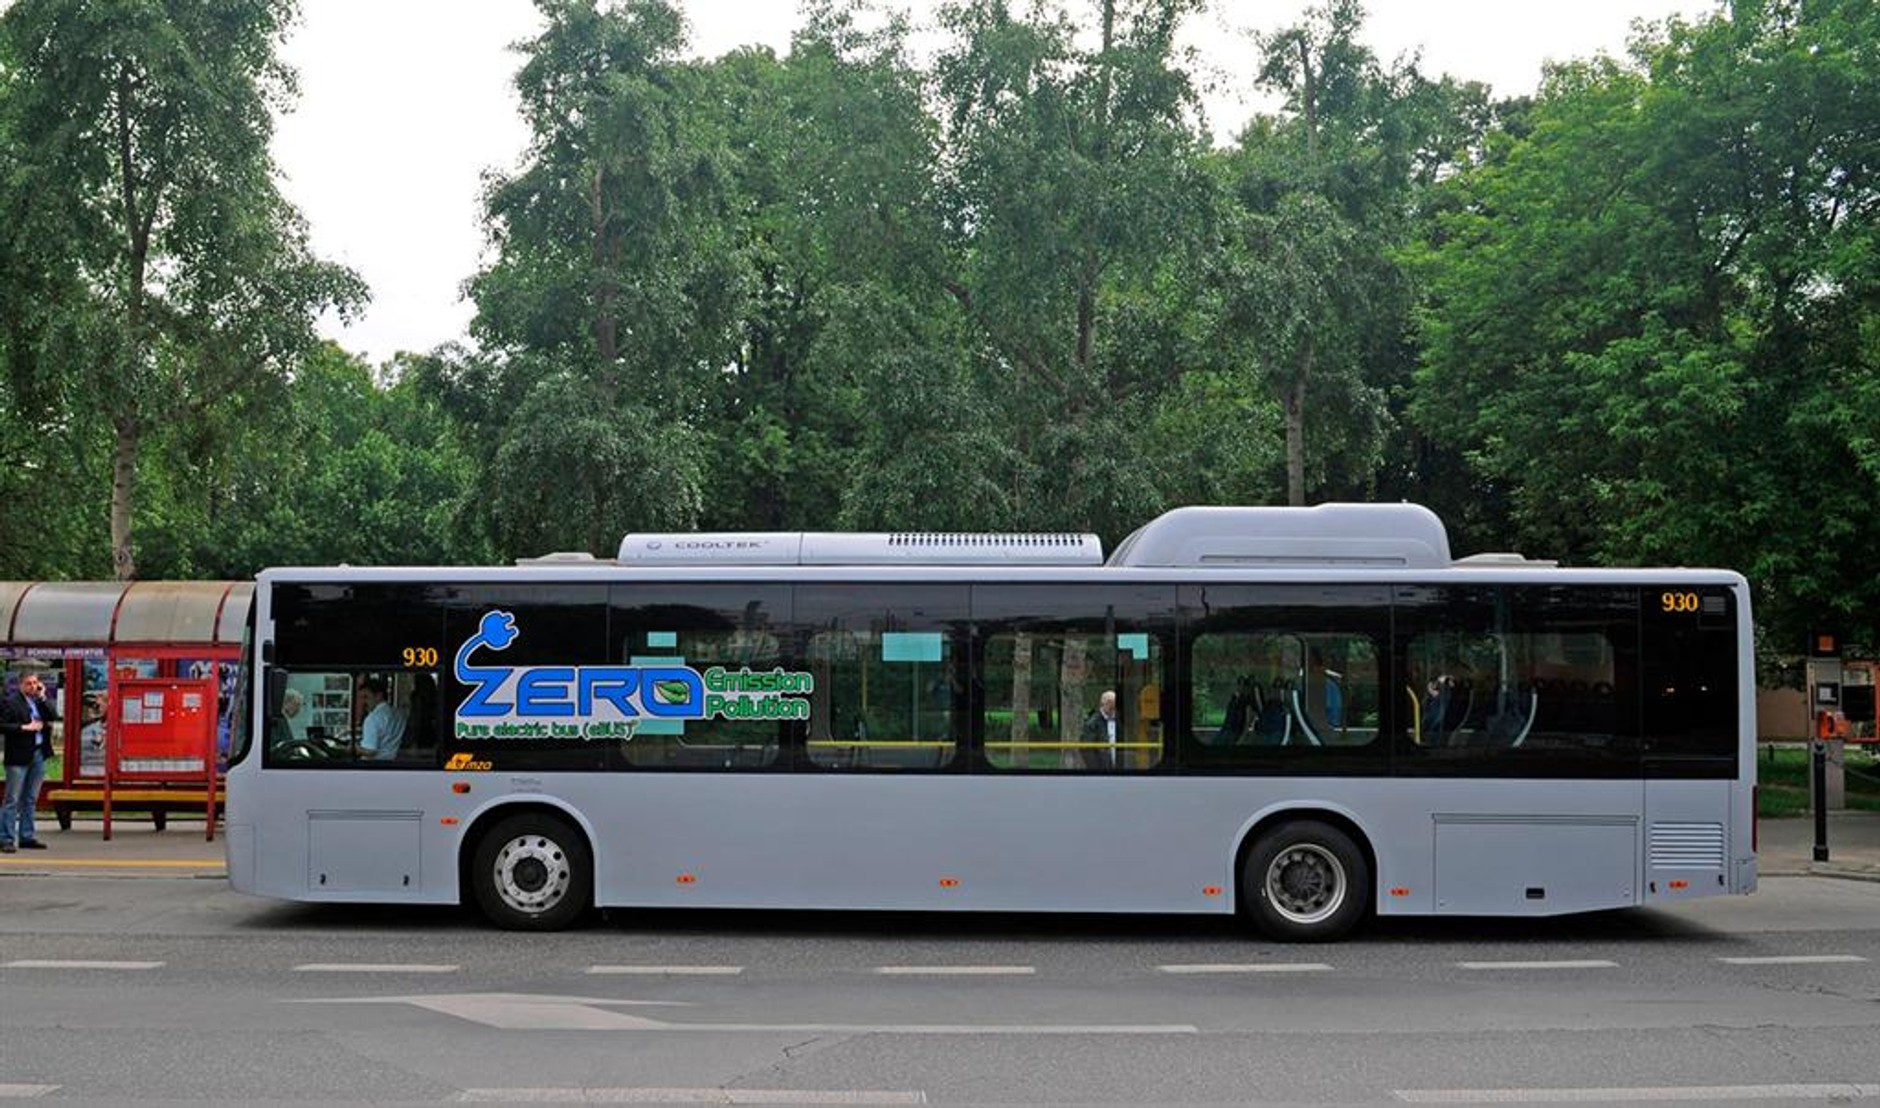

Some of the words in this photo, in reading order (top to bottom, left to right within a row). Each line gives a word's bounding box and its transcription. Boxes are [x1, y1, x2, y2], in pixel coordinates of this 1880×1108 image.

[1662, 592, 1698, 612] 930
[402, 648, 438, 666] 930
[705, 668, 811, 691] Emission
[456, 667, 705, 716] ZERO
[705, 695, 808, 717] Pollution
[457, 723, 489, 736] Pure
[494, 722, 547, 736] electric
[552, 722, 579, 736] bus
